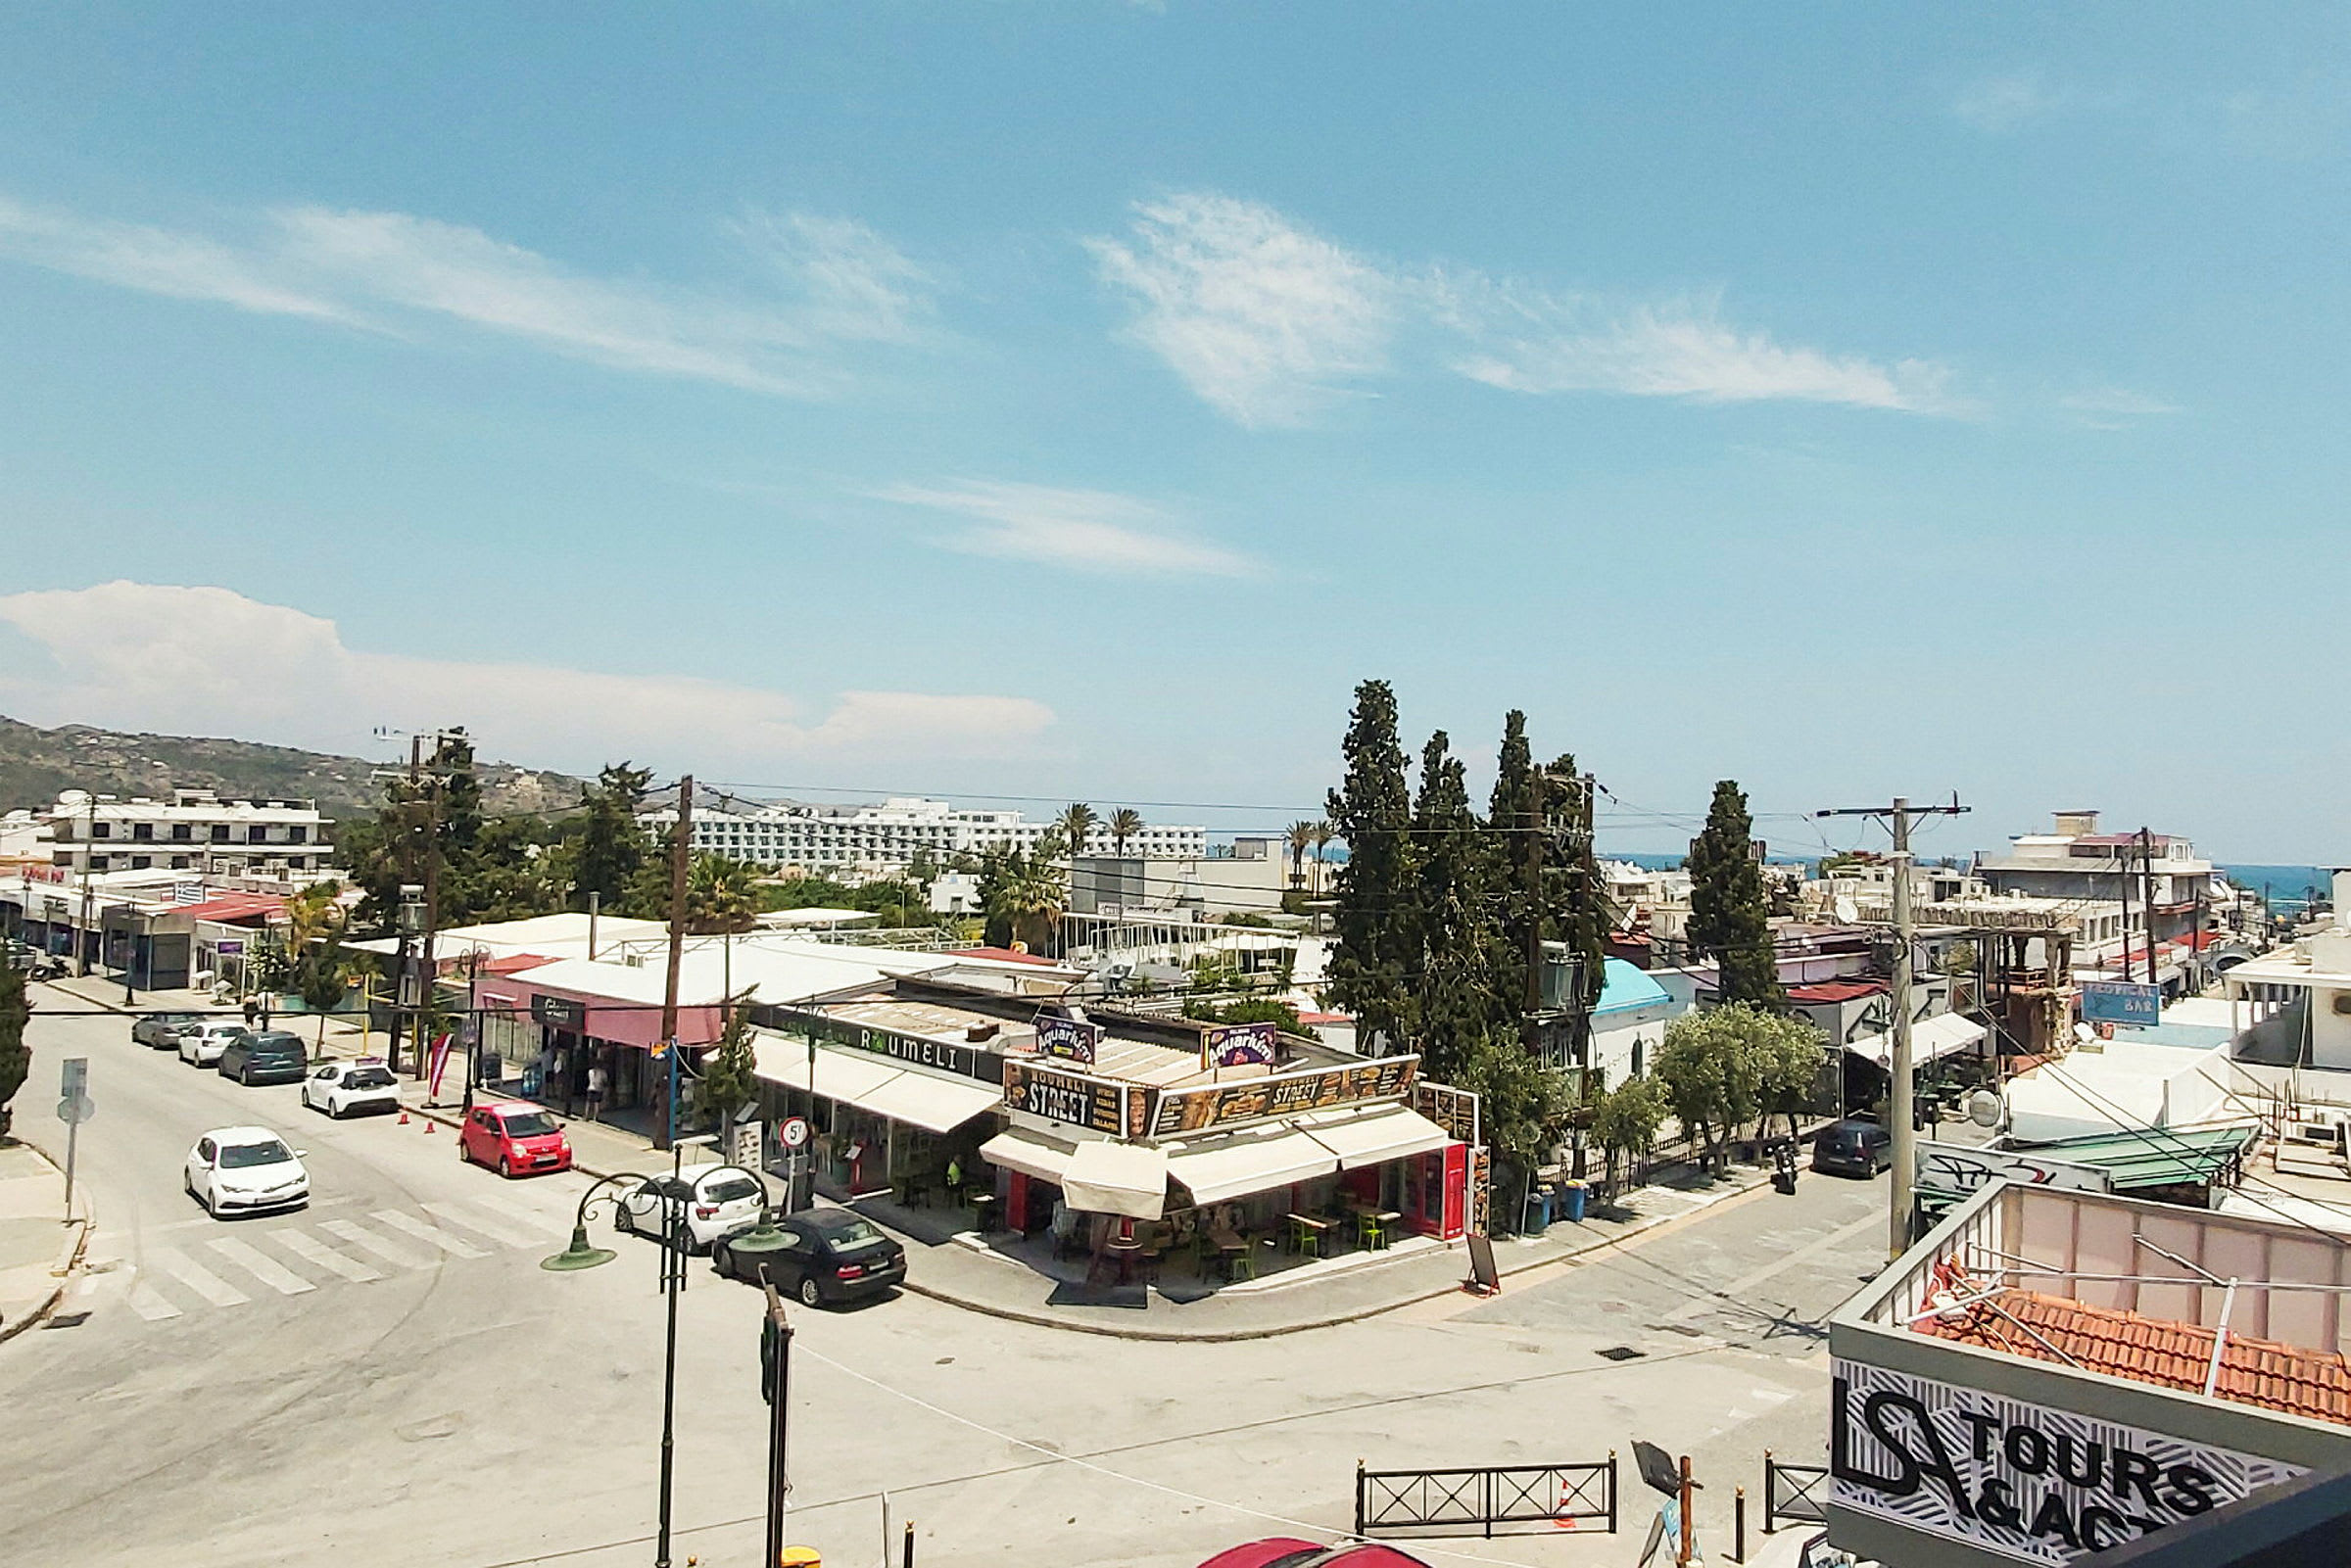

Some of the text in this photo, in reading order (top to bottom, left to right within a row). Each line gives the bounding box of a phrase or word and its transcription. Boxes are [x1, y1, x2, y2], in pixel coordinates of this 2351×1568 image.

[2125, 999, 2152, 1013] BAR
[1209, 1032, 1273, 1068] Aquarium
[1030, 1082, 1088, 1125] STREET
[1272, 1082, 1319, 1105] STREET
[1960, 1410, 2217, 1517] TOURS
